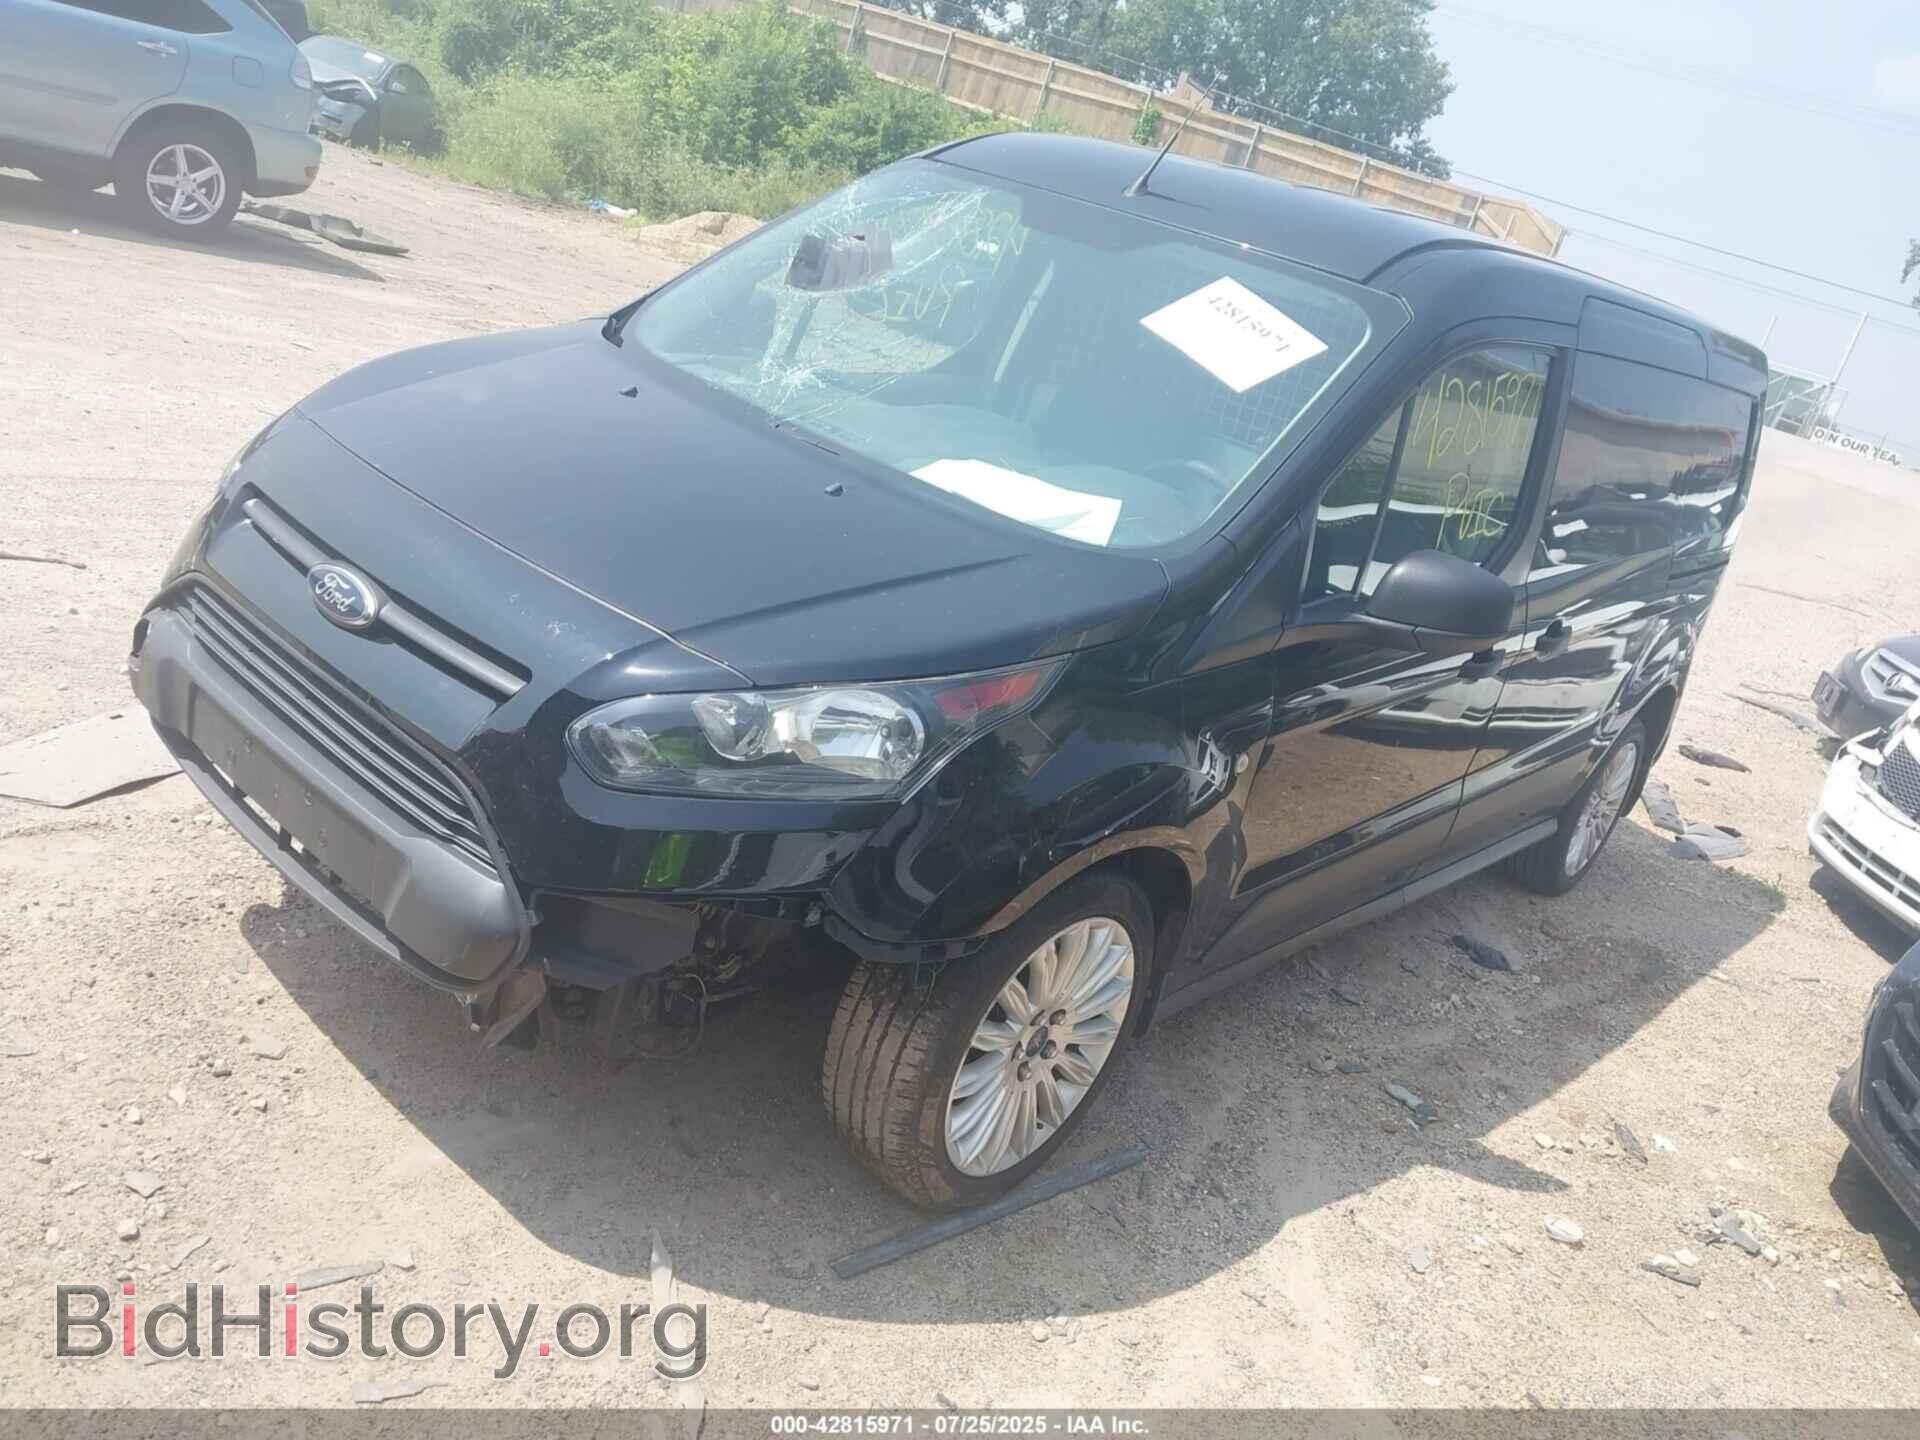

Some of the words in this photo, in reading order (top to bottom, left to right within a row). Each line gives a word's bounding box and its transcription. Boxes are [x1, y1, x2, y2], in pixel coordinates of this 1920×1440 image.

[1841, 438, 1869, 453] OUR
[1872, 446, 1901, 466] TEA
[316, 573, 355, 612] Ford
